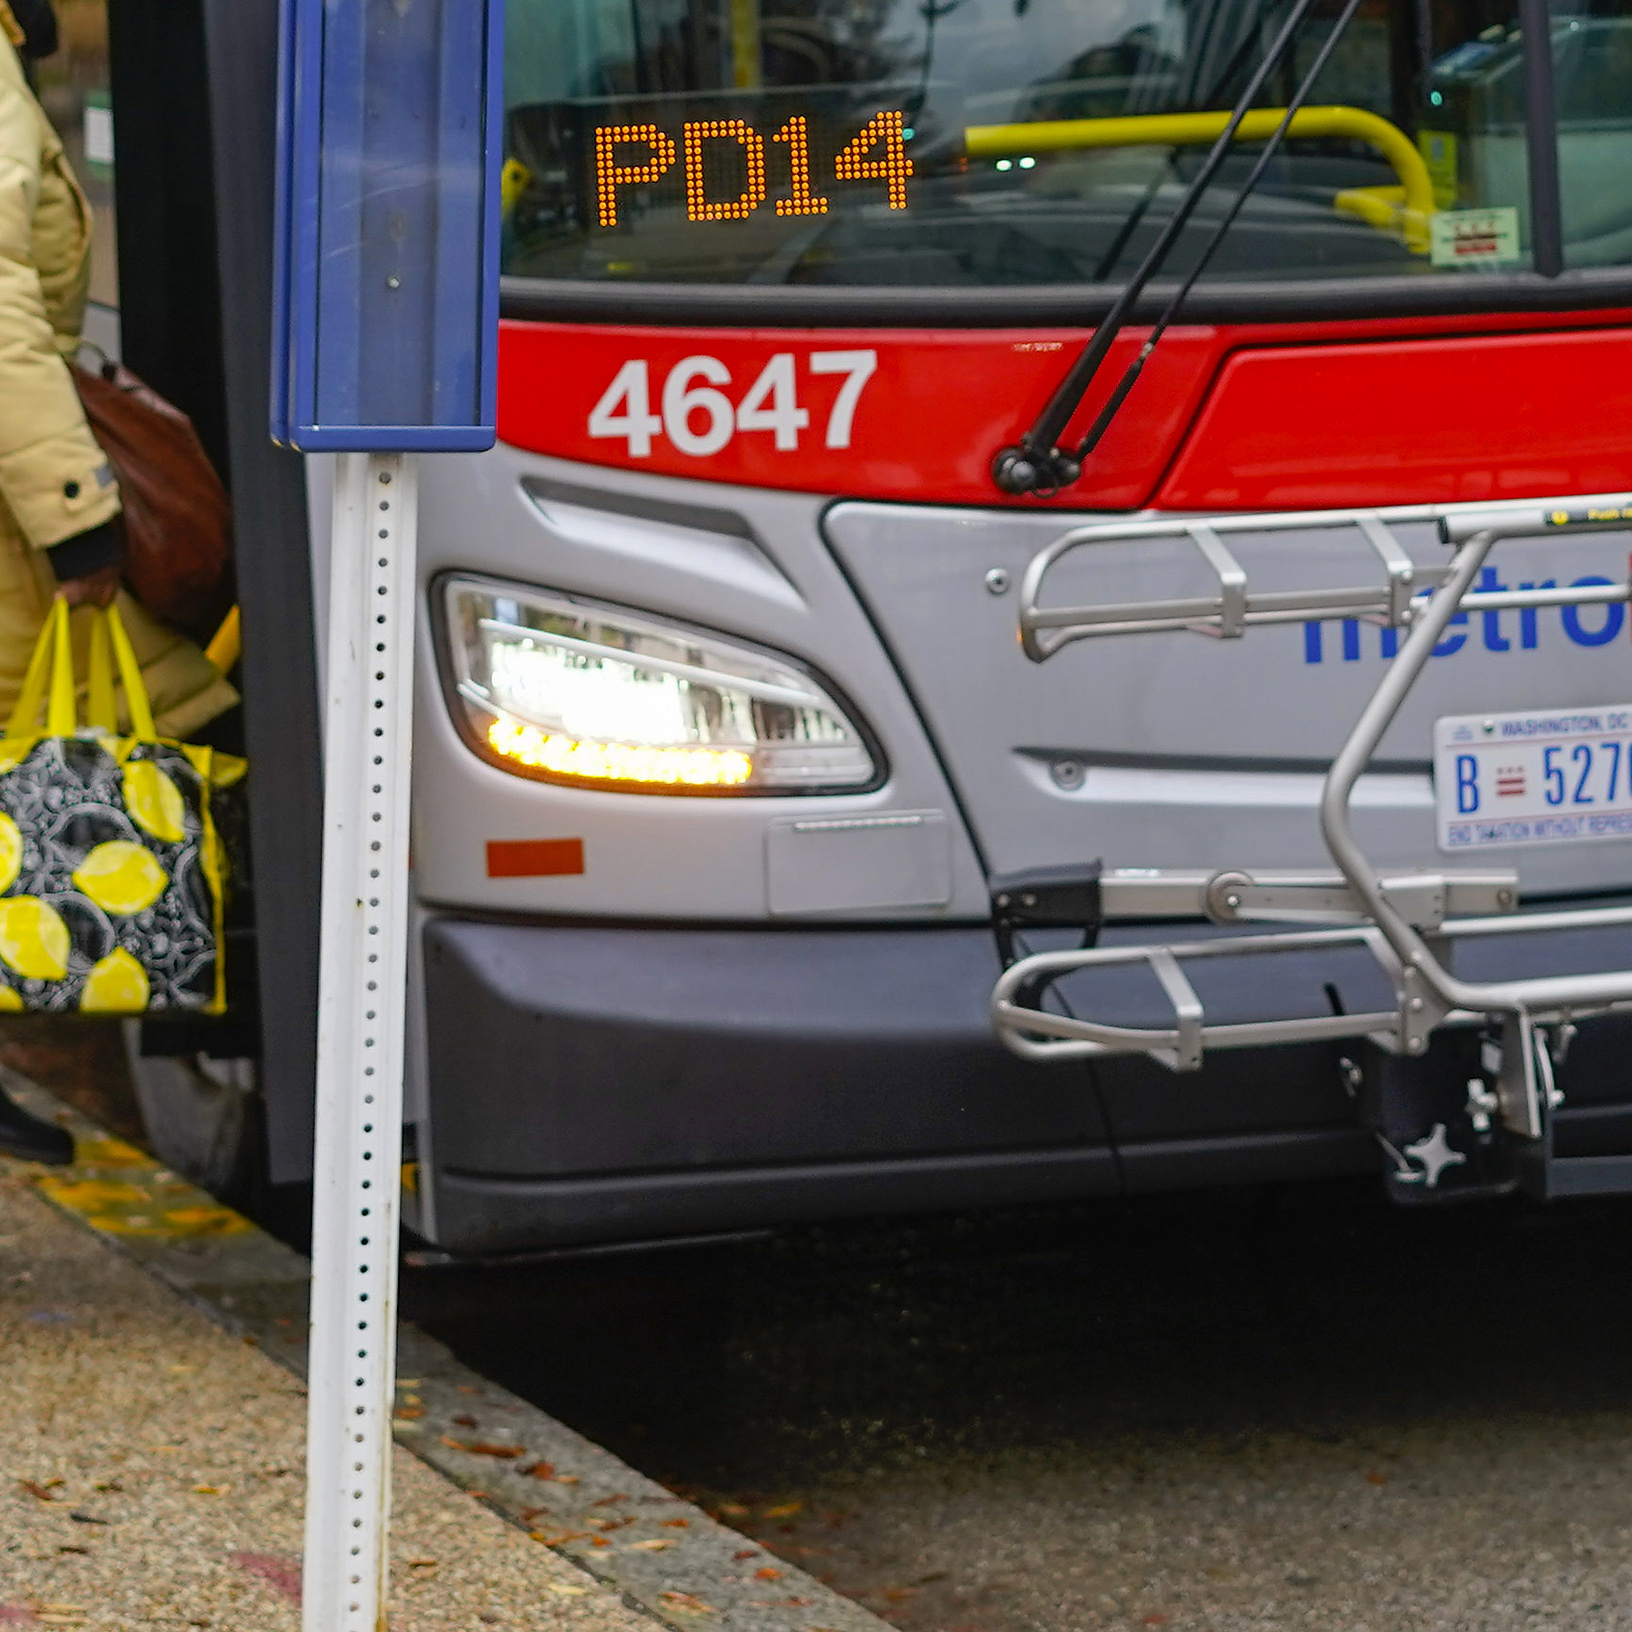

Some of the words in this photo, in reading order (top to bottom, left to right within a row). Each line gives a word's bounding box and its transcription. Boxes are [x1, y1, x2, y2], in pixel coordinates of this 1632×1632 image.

[594, 110, 914, 228] PD14
[587, 349, 878, 458] 4647
[1607, 712, 1630, 730] DC
[1456, 753, 1480, 815] B
